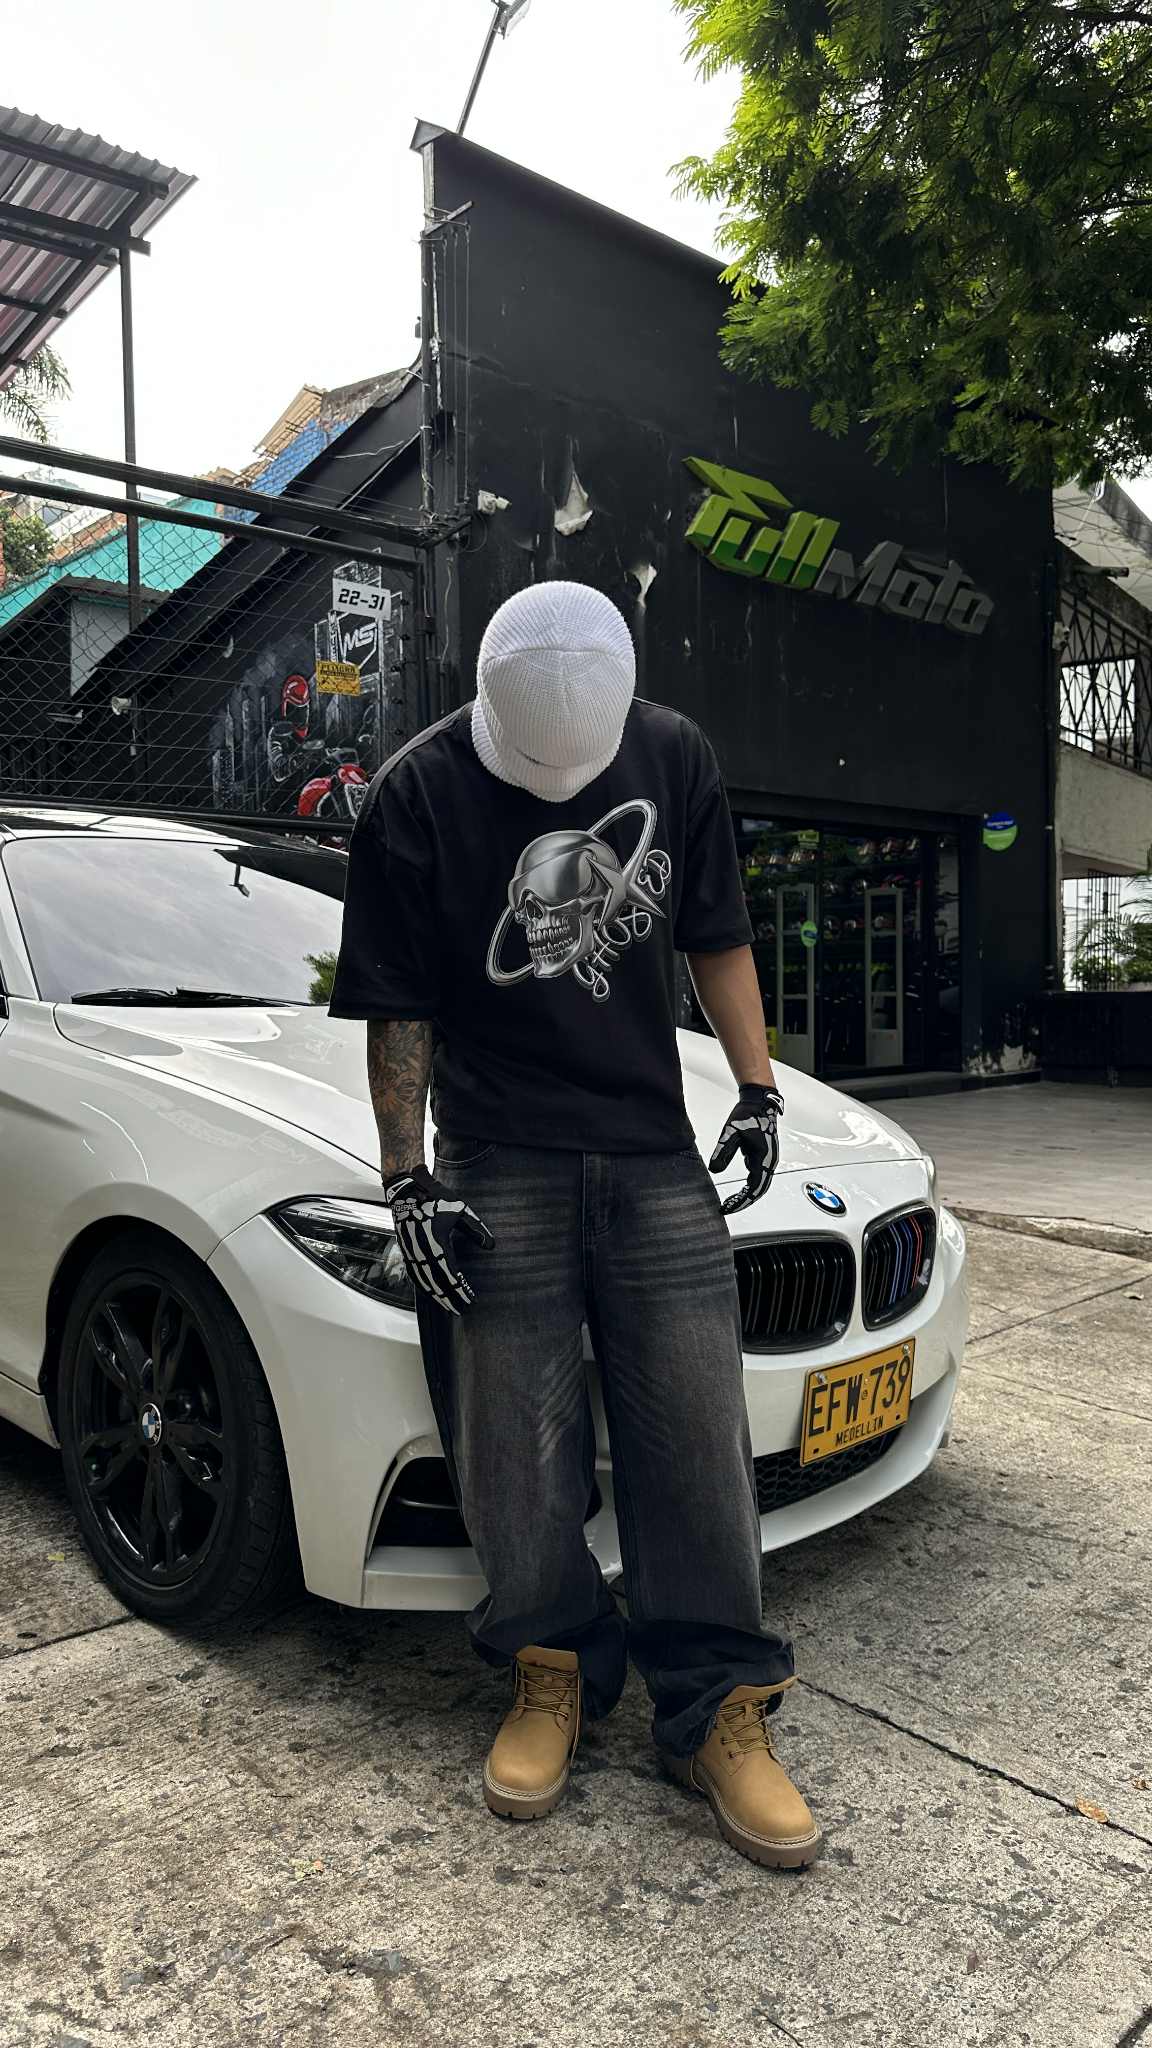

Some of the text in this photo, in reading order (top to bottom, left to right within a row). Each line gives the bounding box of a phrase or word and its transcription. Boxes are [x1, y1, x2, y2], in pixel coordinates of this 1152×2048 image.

[338, 588, 385, 611] 22-31
[808, 1355, 911, 1438] EFW 739
[835, 1415, 884, 1447] MEDELLIN
